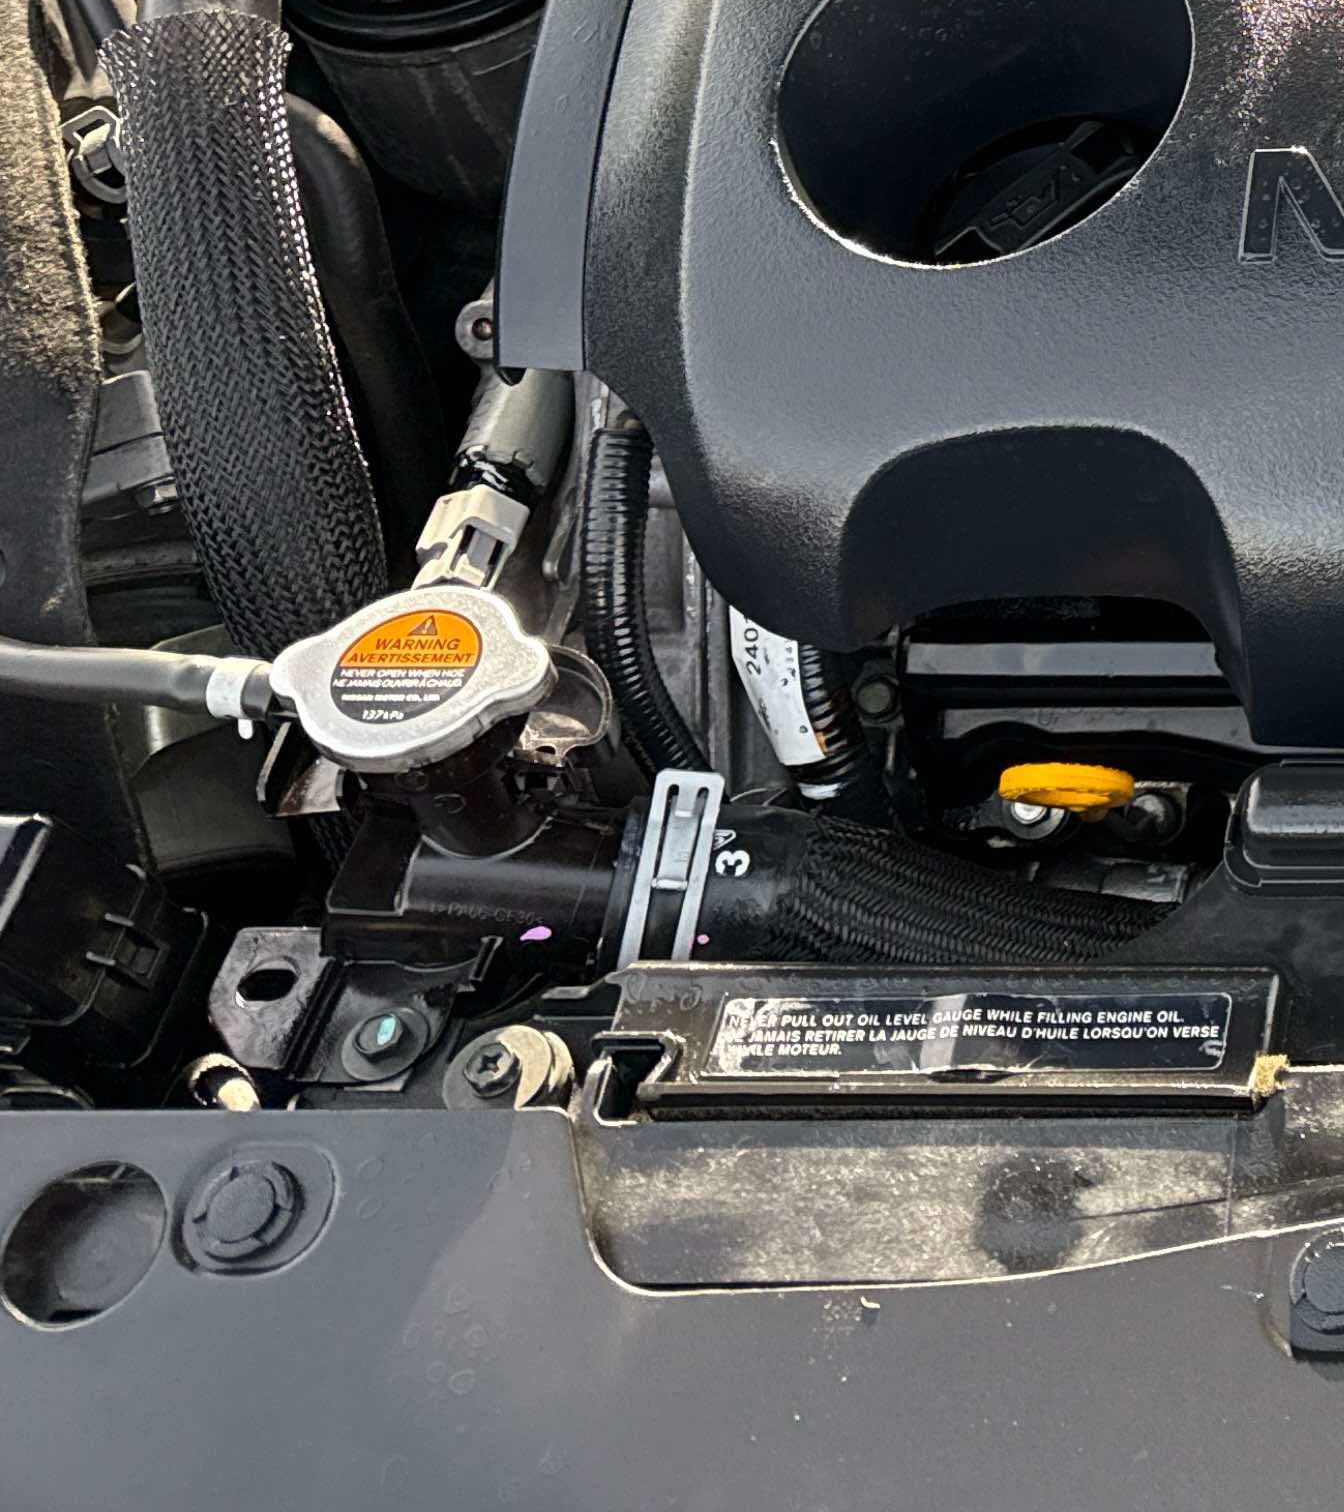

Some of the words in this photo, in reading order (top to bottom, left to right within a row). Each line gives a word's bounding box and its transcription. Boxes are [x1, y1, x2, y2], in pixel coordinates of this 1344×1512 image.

[375, 638, 461, 650] WARNING
[347, 653, 474, 663] AVERTISSEMENT
[341, 669, 375, 677] NEVER
[377, 669, 406, 677] OPEN
[715, 849, 751, 877] 3
[781, 1015, 817, 1027] PULL
[822, 1014, 853, 1027] OUT
[857, 1014, 880, 1026] OIL
[885, 1012, 927, 1026] LEVEL
[932, 1008, 983, 1024] GAUGE
[986, 1010, 1033, 1023] WHILE
[1037, 1011, 1093, 1024] FILLING
[1097, 1011, 1153, 1023] ENGINE
[748, 1030, 801, 1043] JAMAIS
[805, 1029, 866, 1042] RETIRER
[869, 1030, 887, 1042] LA
[889, 1028, 936, 1041] JAUGE
[939, 1025, 958, 1038] DE
[962, 1025, 1017, 1038] NIVEAU
[1021, 1027, 1079, 1039] D'HUILE
[1083, 1026, 1168, 1039] LORSQU'ON
[1172, 1025, 1220, 1038] VERSE
[779, 1043, 842, 1056] MOTEUR.
